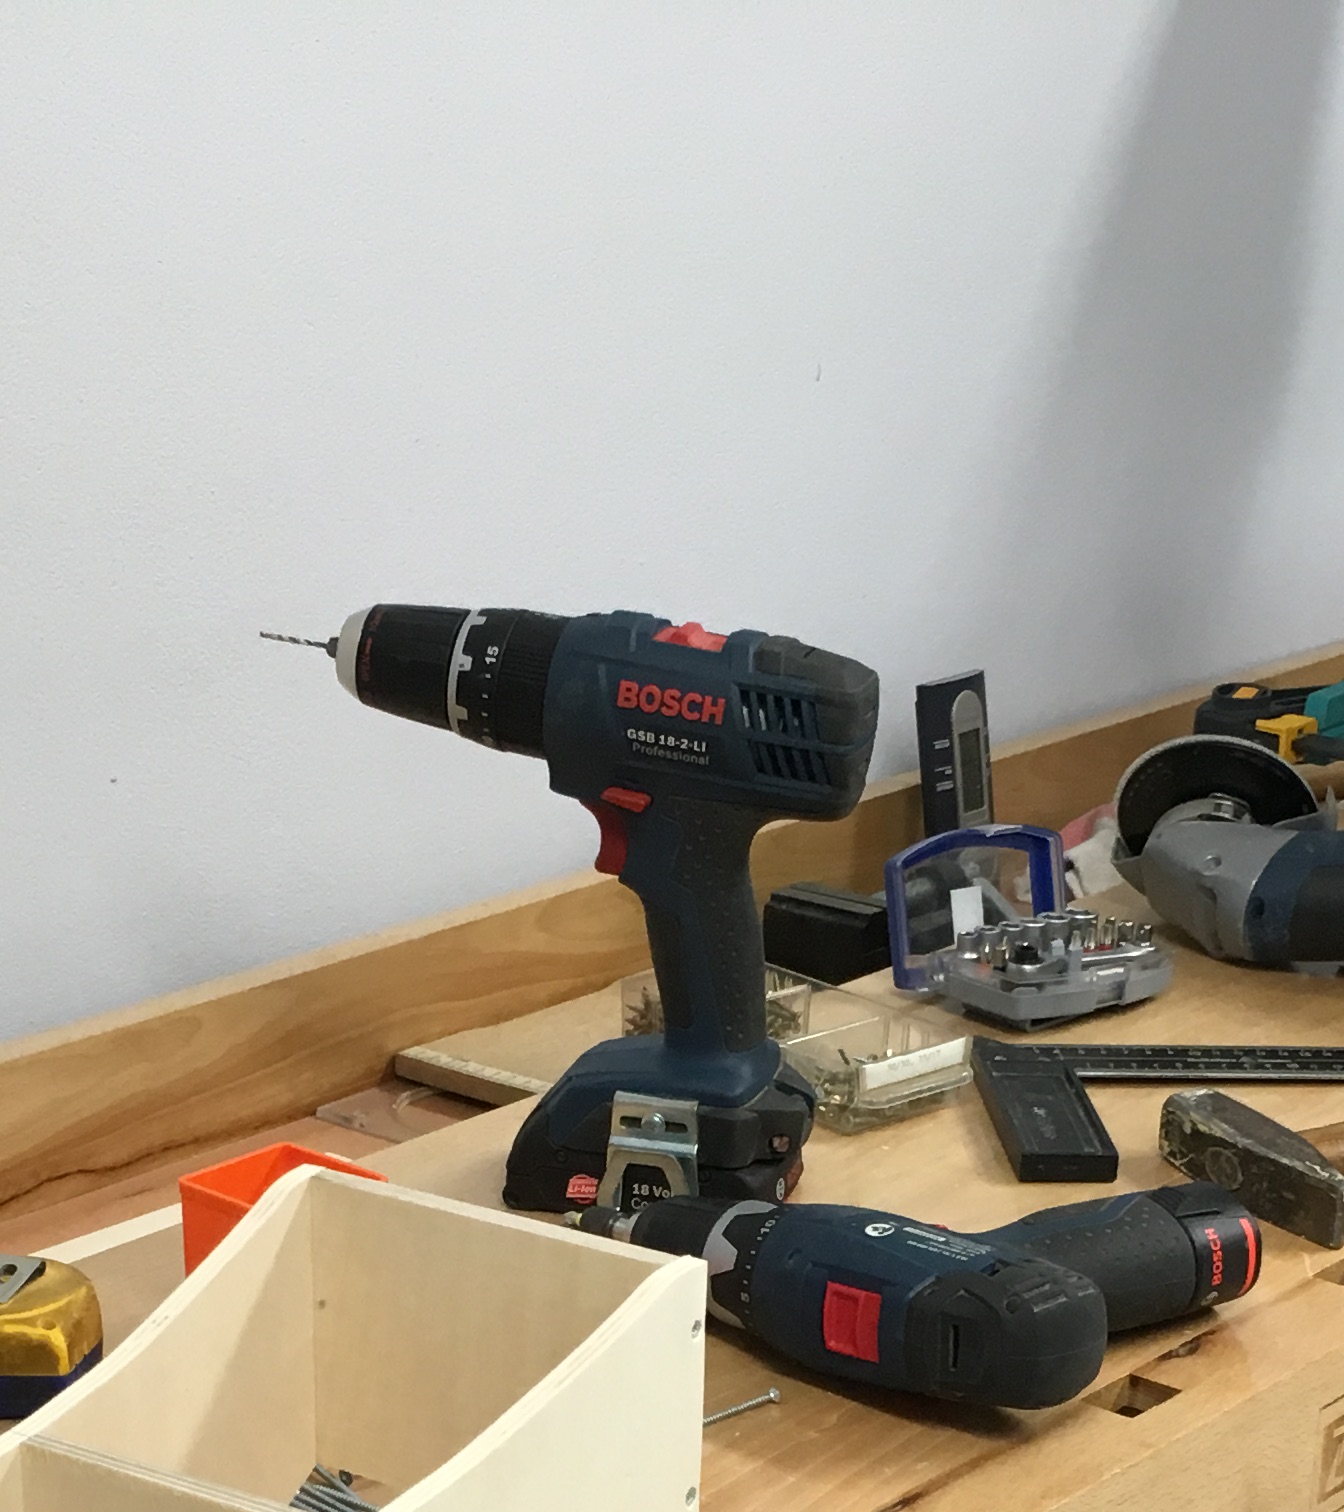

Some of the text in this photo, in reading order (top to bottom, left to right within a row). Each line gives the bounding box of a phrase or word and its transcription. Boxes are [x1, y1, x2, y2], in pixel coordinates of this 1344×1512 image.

[485, 645, 499, 664] 15
[617, 679, 726, 726] BOSCH
[627, 728, 706, 752] GSB 18-2-LI
[632, 742, 709, 765] Professional
[632, 1183, 649, 1195] 18
[631, 1197, 649, 1209] Co
[760, 1219, 776, 1235] 10
[1204, 1228, 1223, 1287] BOSCH
